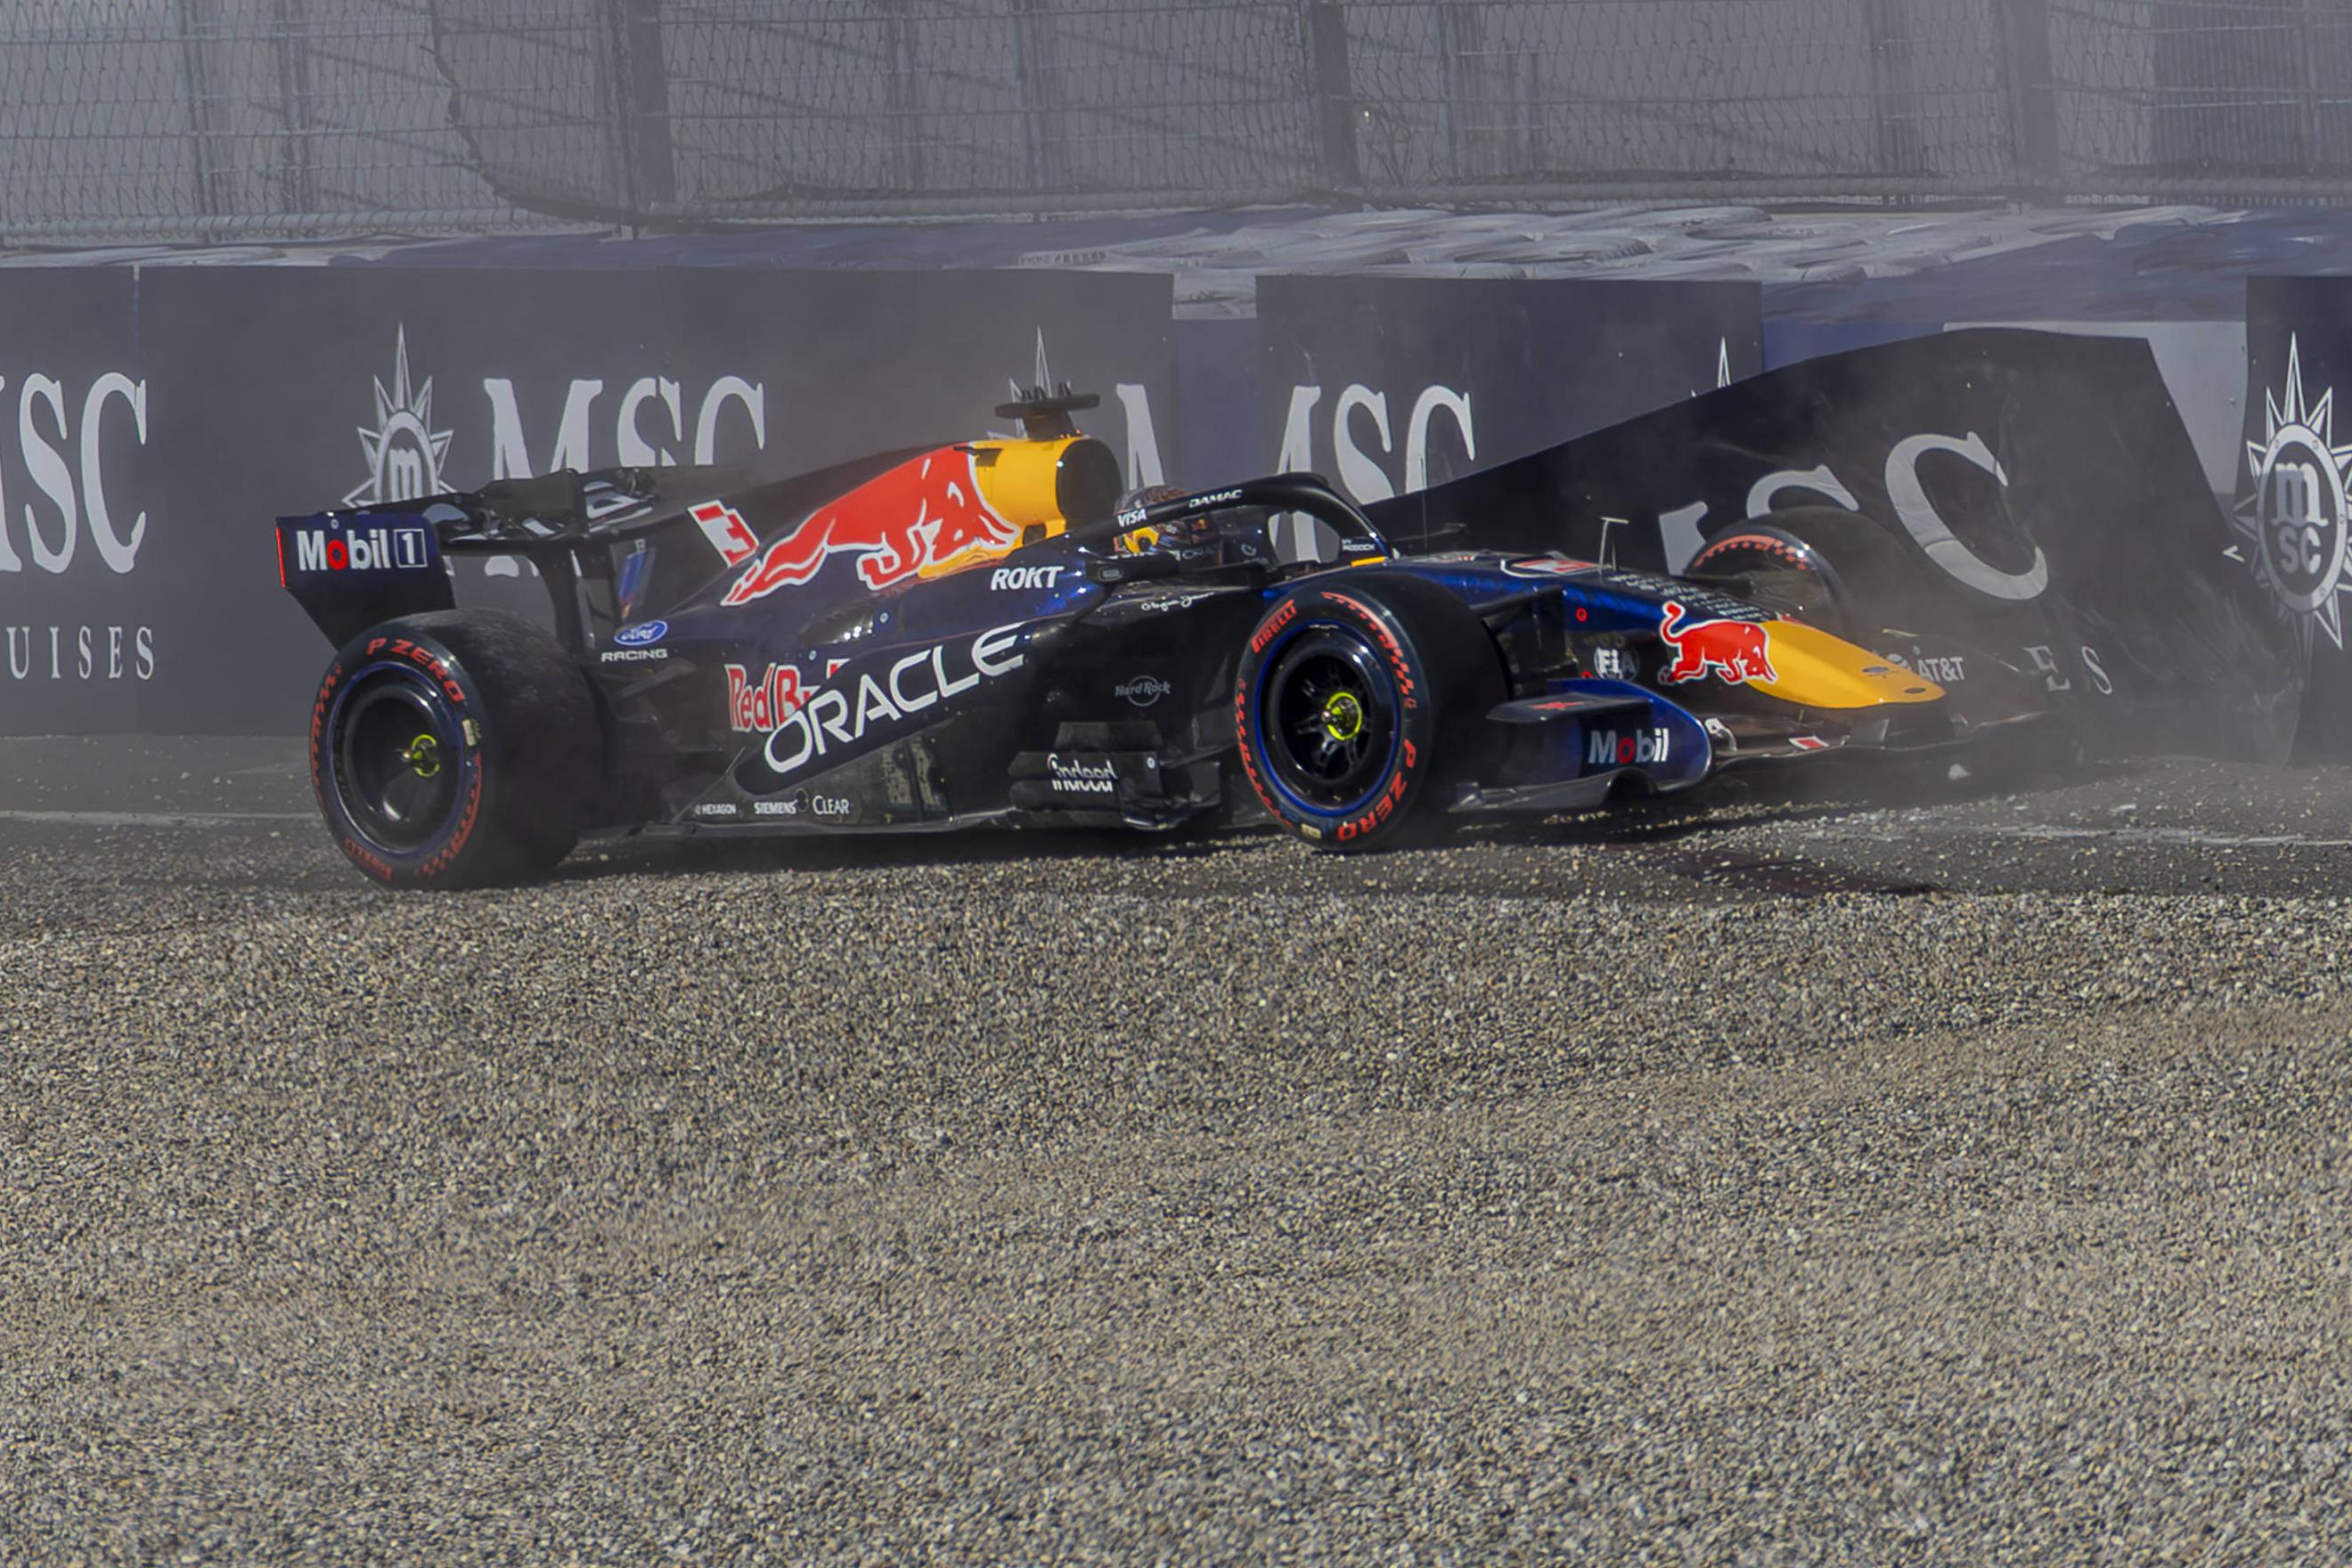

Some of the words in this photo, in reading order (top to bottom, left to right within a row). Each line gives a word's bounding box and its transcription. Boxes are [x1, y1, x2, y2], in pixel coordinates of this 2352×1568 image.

[0, 372, 146, 574] SC
[1188, 489, 1242, 508] DAMAC
[1117, 508, 1147, 527] VISA
[296, 529, 391, 571] Mobil
[991, 565, 1065, 591] ROKT
[366, 637, 387, 656] P
[390, 639, 466, 703] ZERO
[600, 649, 669, 663] RACING
[1917, 657, 1964, 682] AT&T
[724, 662, 777, 732] Red
[764, 622, 1026, 773] ORACLE
[1115, 684, 1143, 697] Hard
[1144, 681, 1171, 696] Rock
[1404, 739, 1417, 769] P
[1588, 727, 1669, 764] Mobil
[754, 801, 796, 814] SIEMENS
[1338, 772, 1408, 842] ZERO
